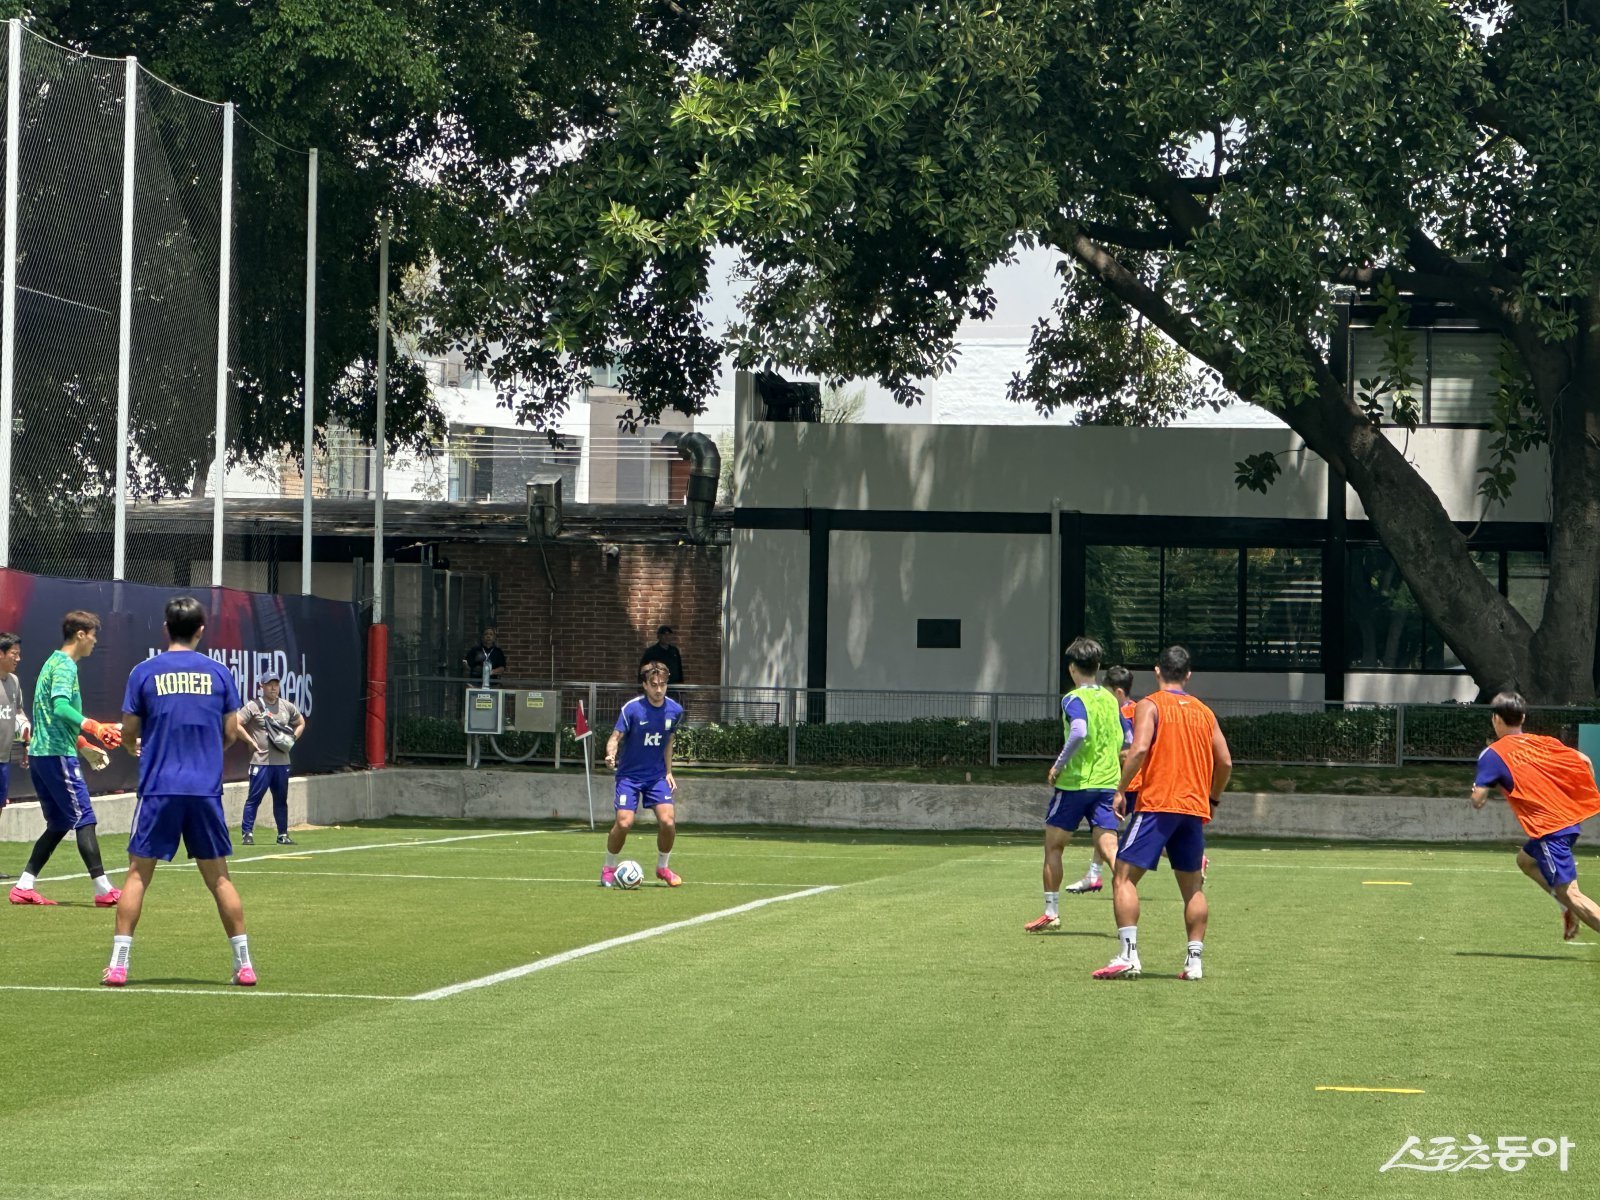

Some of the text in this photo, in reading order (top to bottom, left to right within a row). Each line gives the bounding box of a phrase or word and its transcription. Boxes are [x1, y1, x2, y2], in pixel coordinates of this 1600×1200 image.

[154, 672, 212, 696] KOREA
[274, 650, 312, 718] Reds
[643, 732, 663, 746] kt
